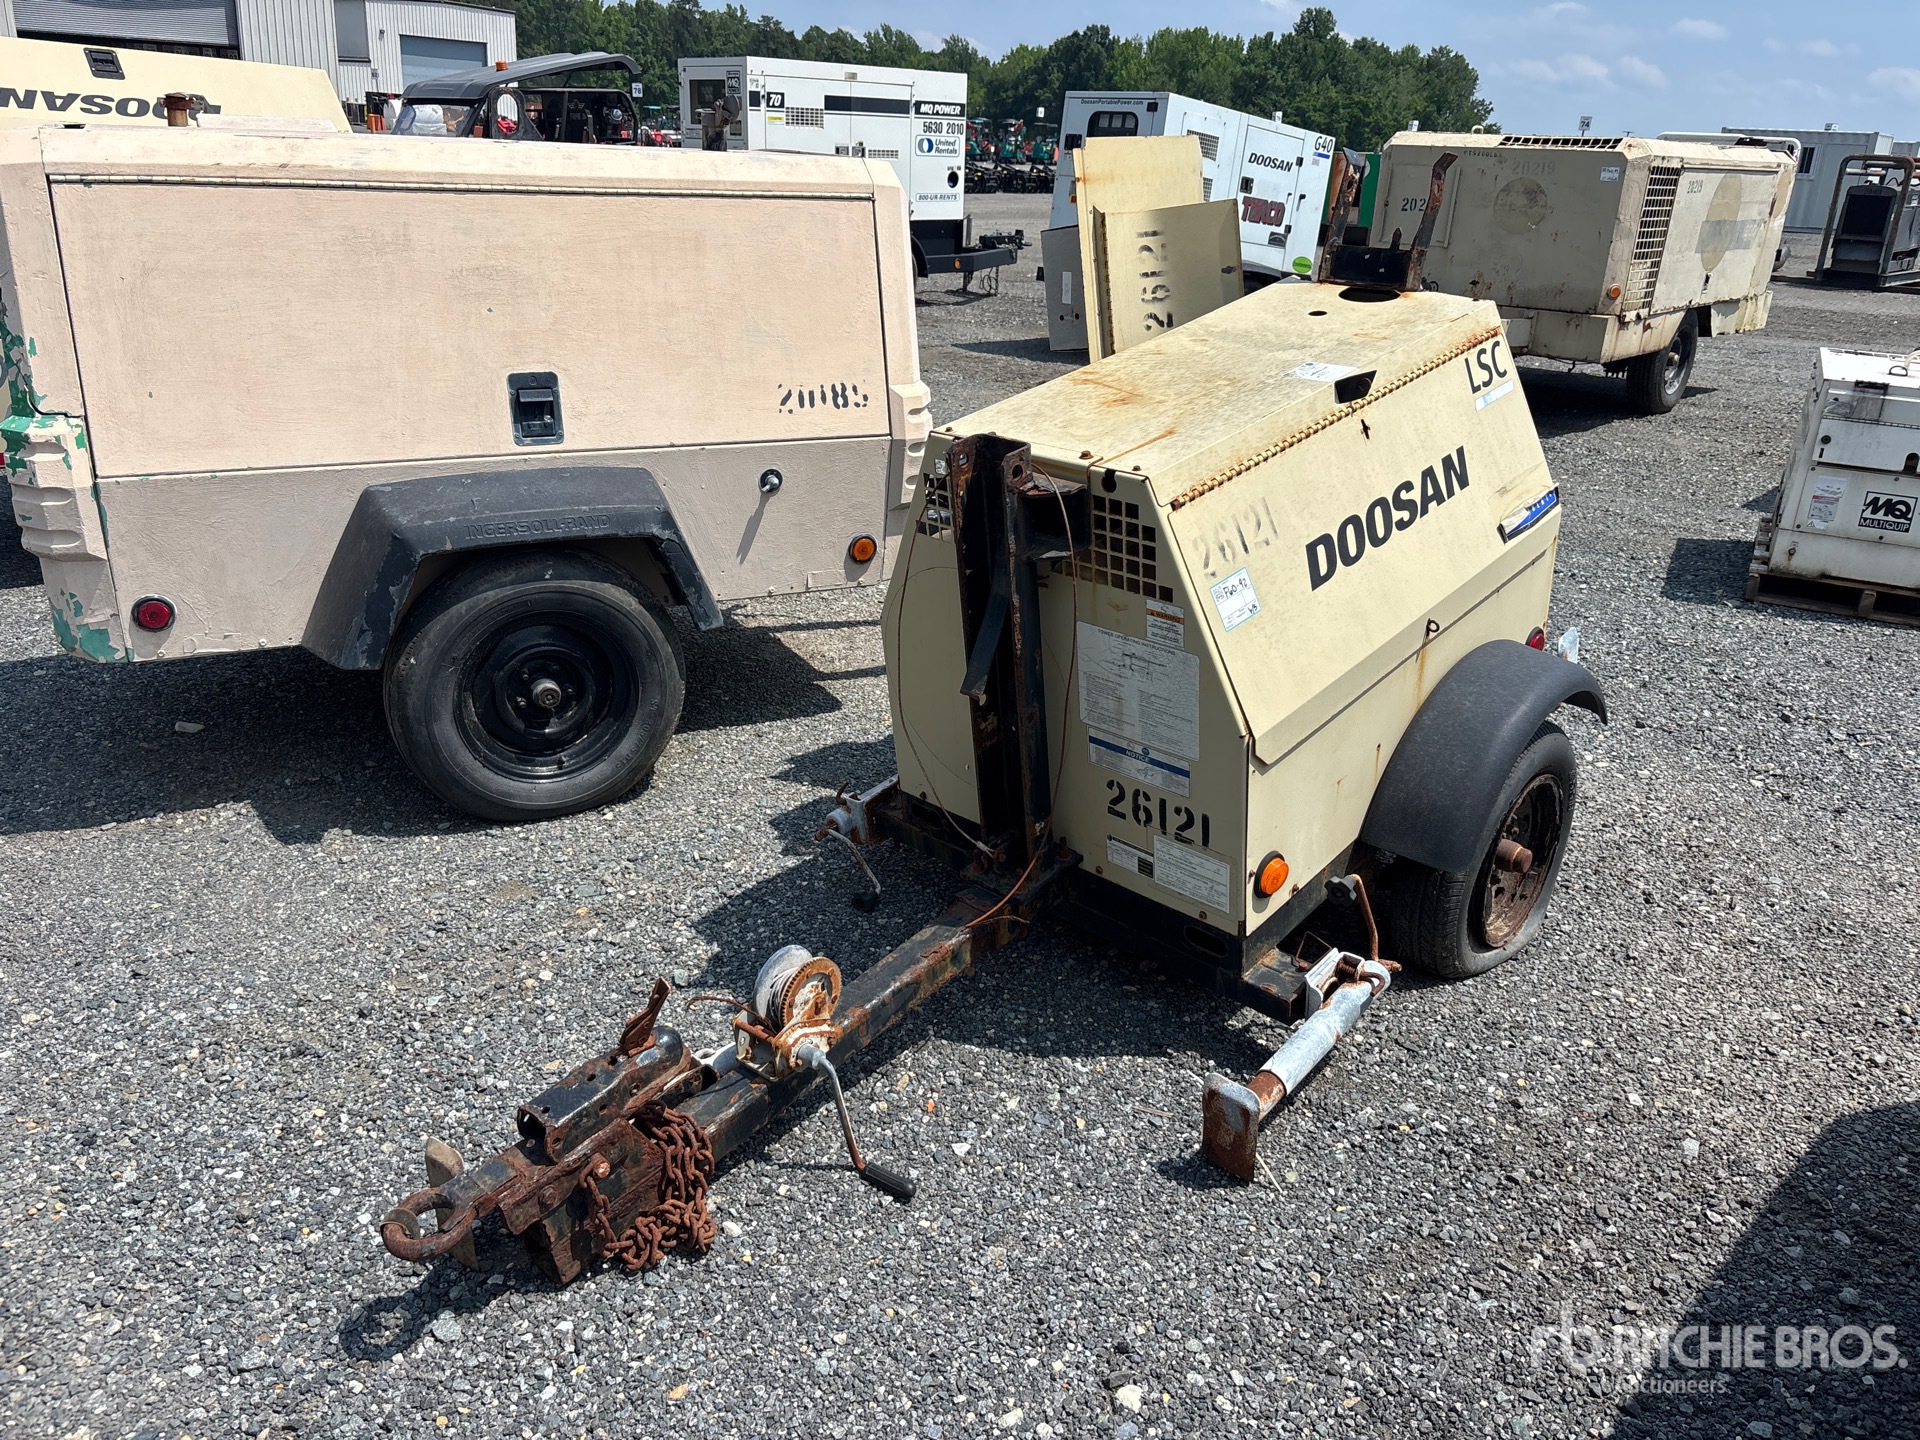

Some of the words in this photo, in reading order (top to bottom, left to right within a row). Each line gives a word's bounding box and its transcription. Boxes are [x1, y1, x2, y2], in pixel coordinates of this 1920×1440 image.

[633, 87, 642, 95] 78
[769, 94, 782, 106] 70
[1080, 98, 1144, 106] DoosanPortablePower.com
[920, 103, 933, 114] MQ
[933, 104, 961, 115] POWER
[922, 121, 943, 134] 5630
[946, 122, 964, 135] 2010
[1580, 120, 1590, 128] 74
[934, 146, 958, 154] Rentals
[935, 139, 957, 147] United
[1314, 136, 1334, 153] G40
[1248, 152, 1294, 172] DOOSAN
[1400, 197, 1427, 212] 202
[1136, 229, 1174, 332] 26121
[1464, 340, 1508, 394] LSC
[1863, 496, 1912, 524] MQ
[1305, 445, 1470, 592] DOOSAN
[1860, 518, 1910, 532] MULTIQUIP
[465, 513, 611, 540] INGERSOLL-RAND
[1192, 496, 1279, 580] 26121
[1097, 628, 1116, 639] TOWER
[1114, 633, 1141, 646] OPERATING
[1140, 640, 1176, 656] INSTRUCTIONS
[1125, 749, 1150, 763] NOTICE
[1106, 779, 1210, 848] 26121
